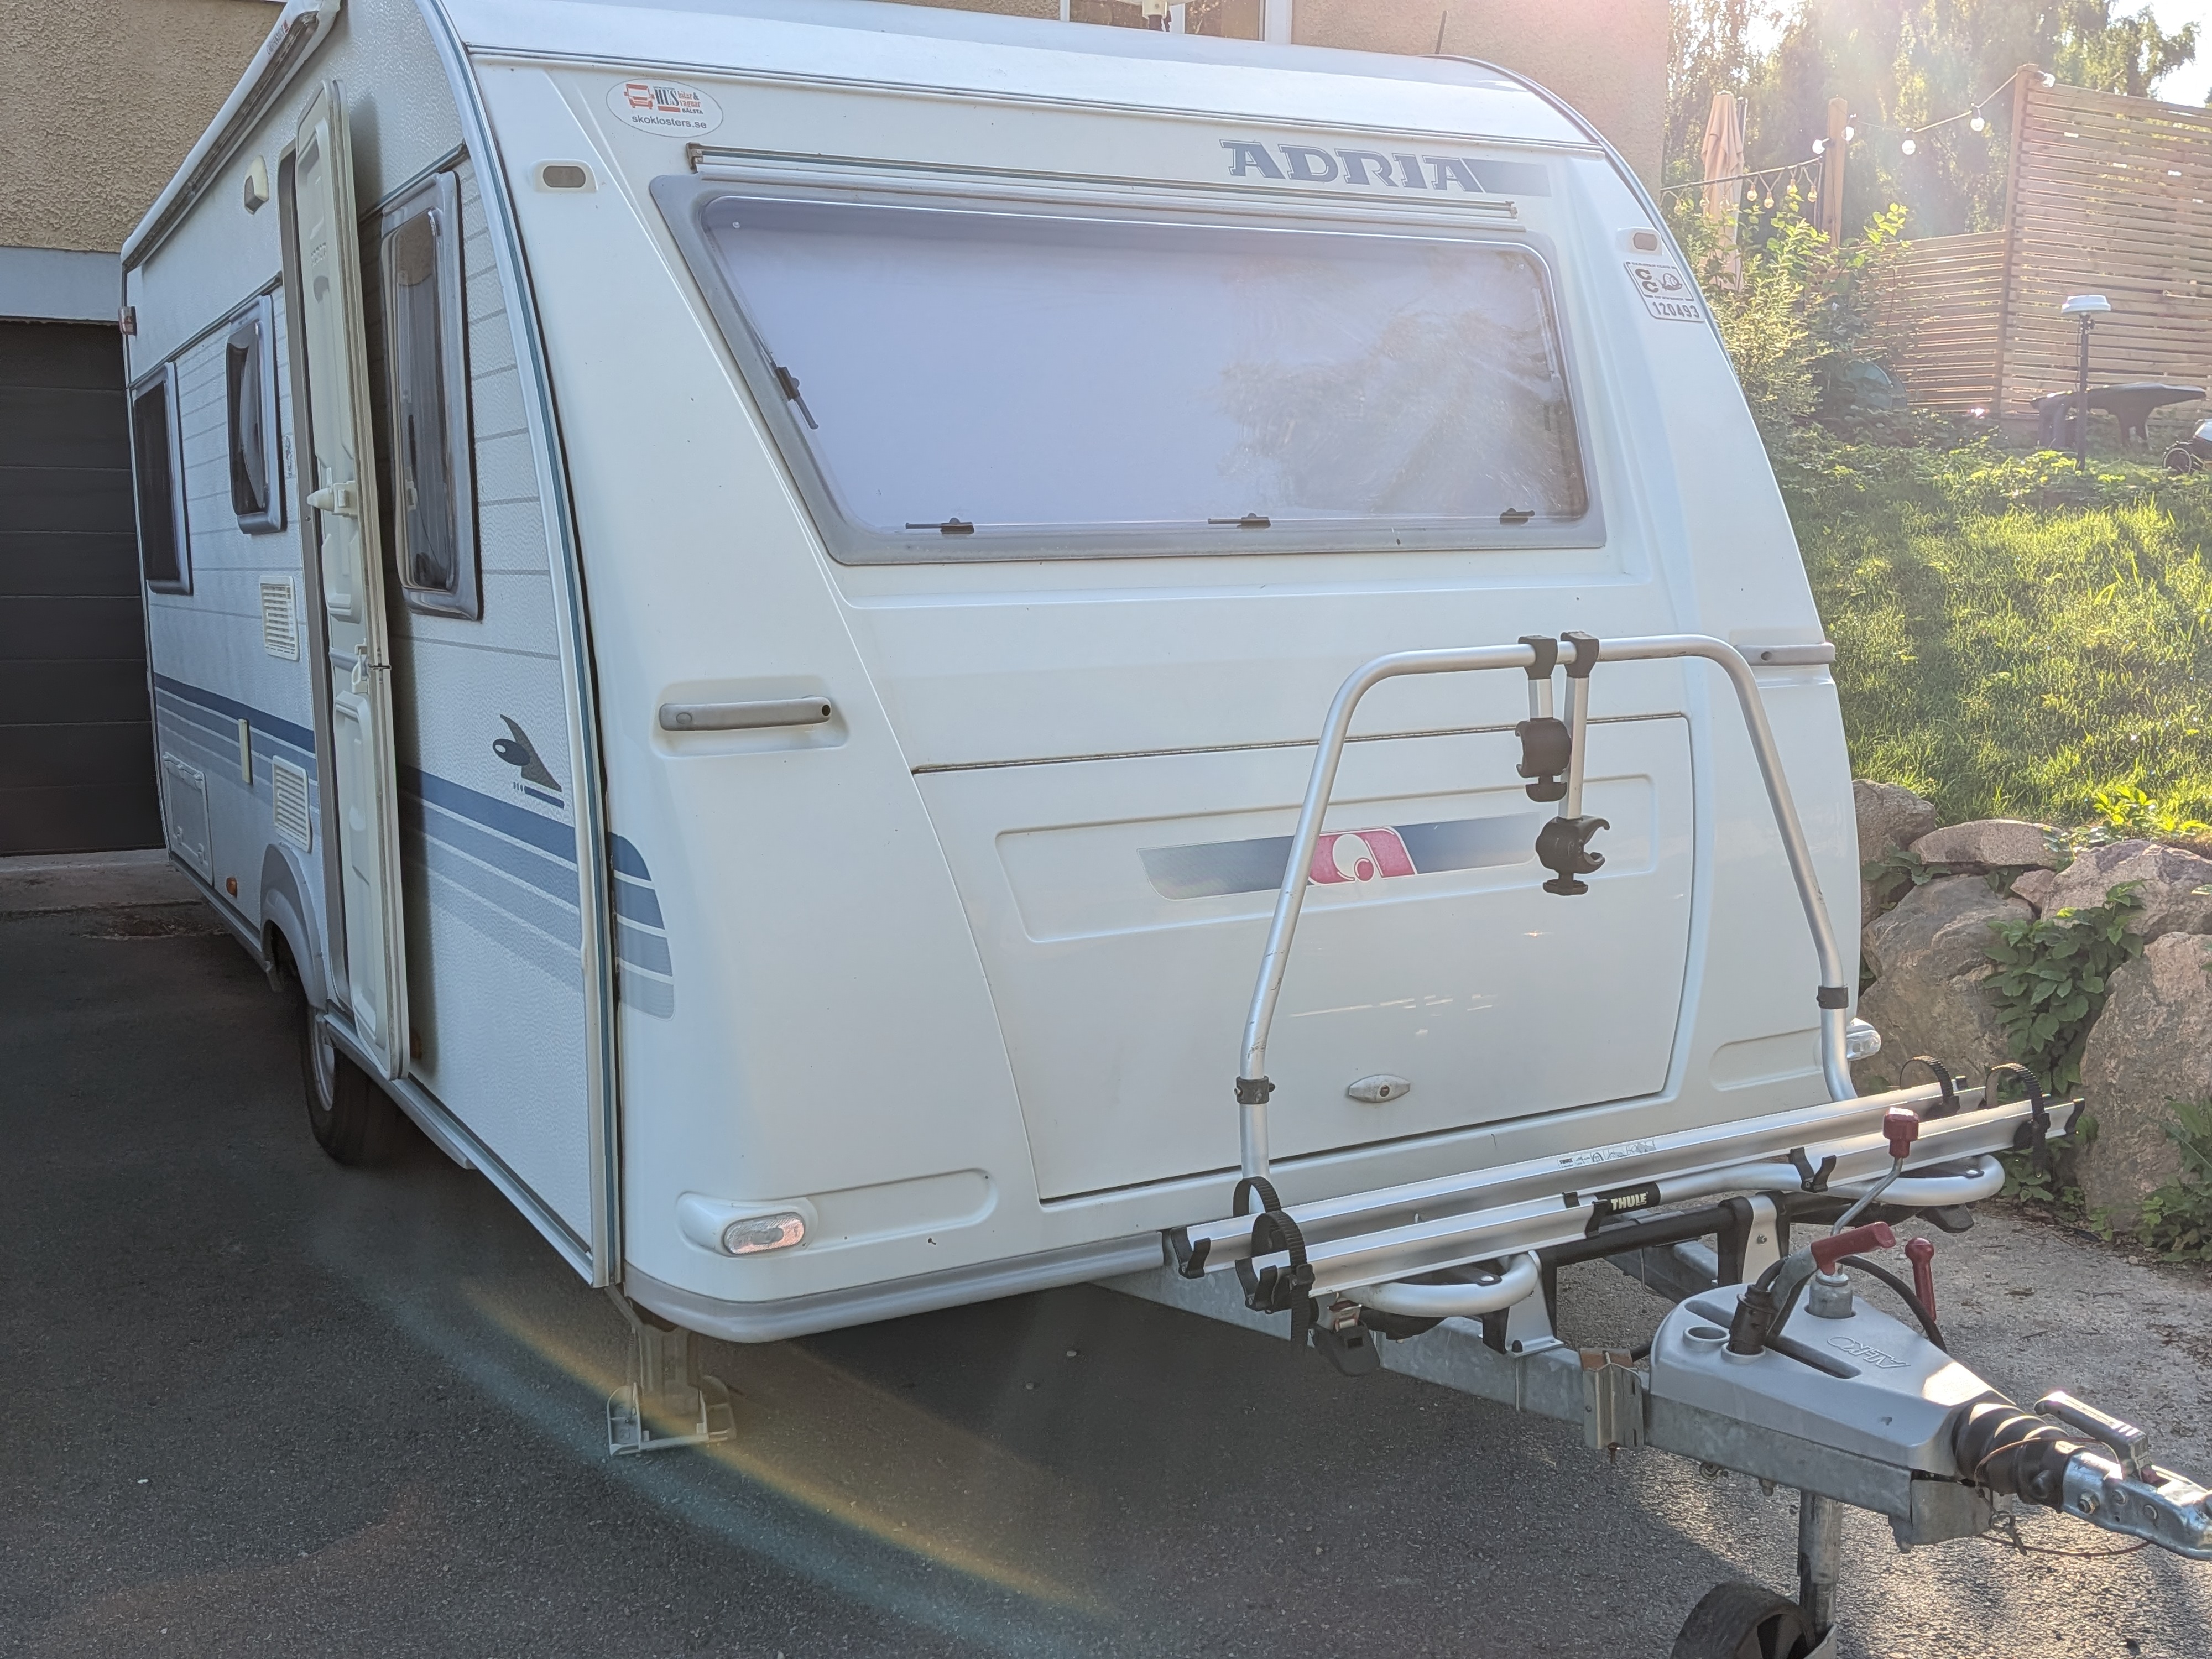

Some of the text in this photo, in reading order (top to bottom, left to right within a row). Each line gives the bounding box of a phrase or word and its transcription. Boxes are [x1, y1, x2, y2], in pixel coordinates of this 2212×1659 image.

[632, 115, 707, 129] skoklosters.se
[1219, 139, 1485, 193] ADRIA
[1652, 301, 1700, 319] 120493
[1610, 1192, 1647, 1211] THULE
